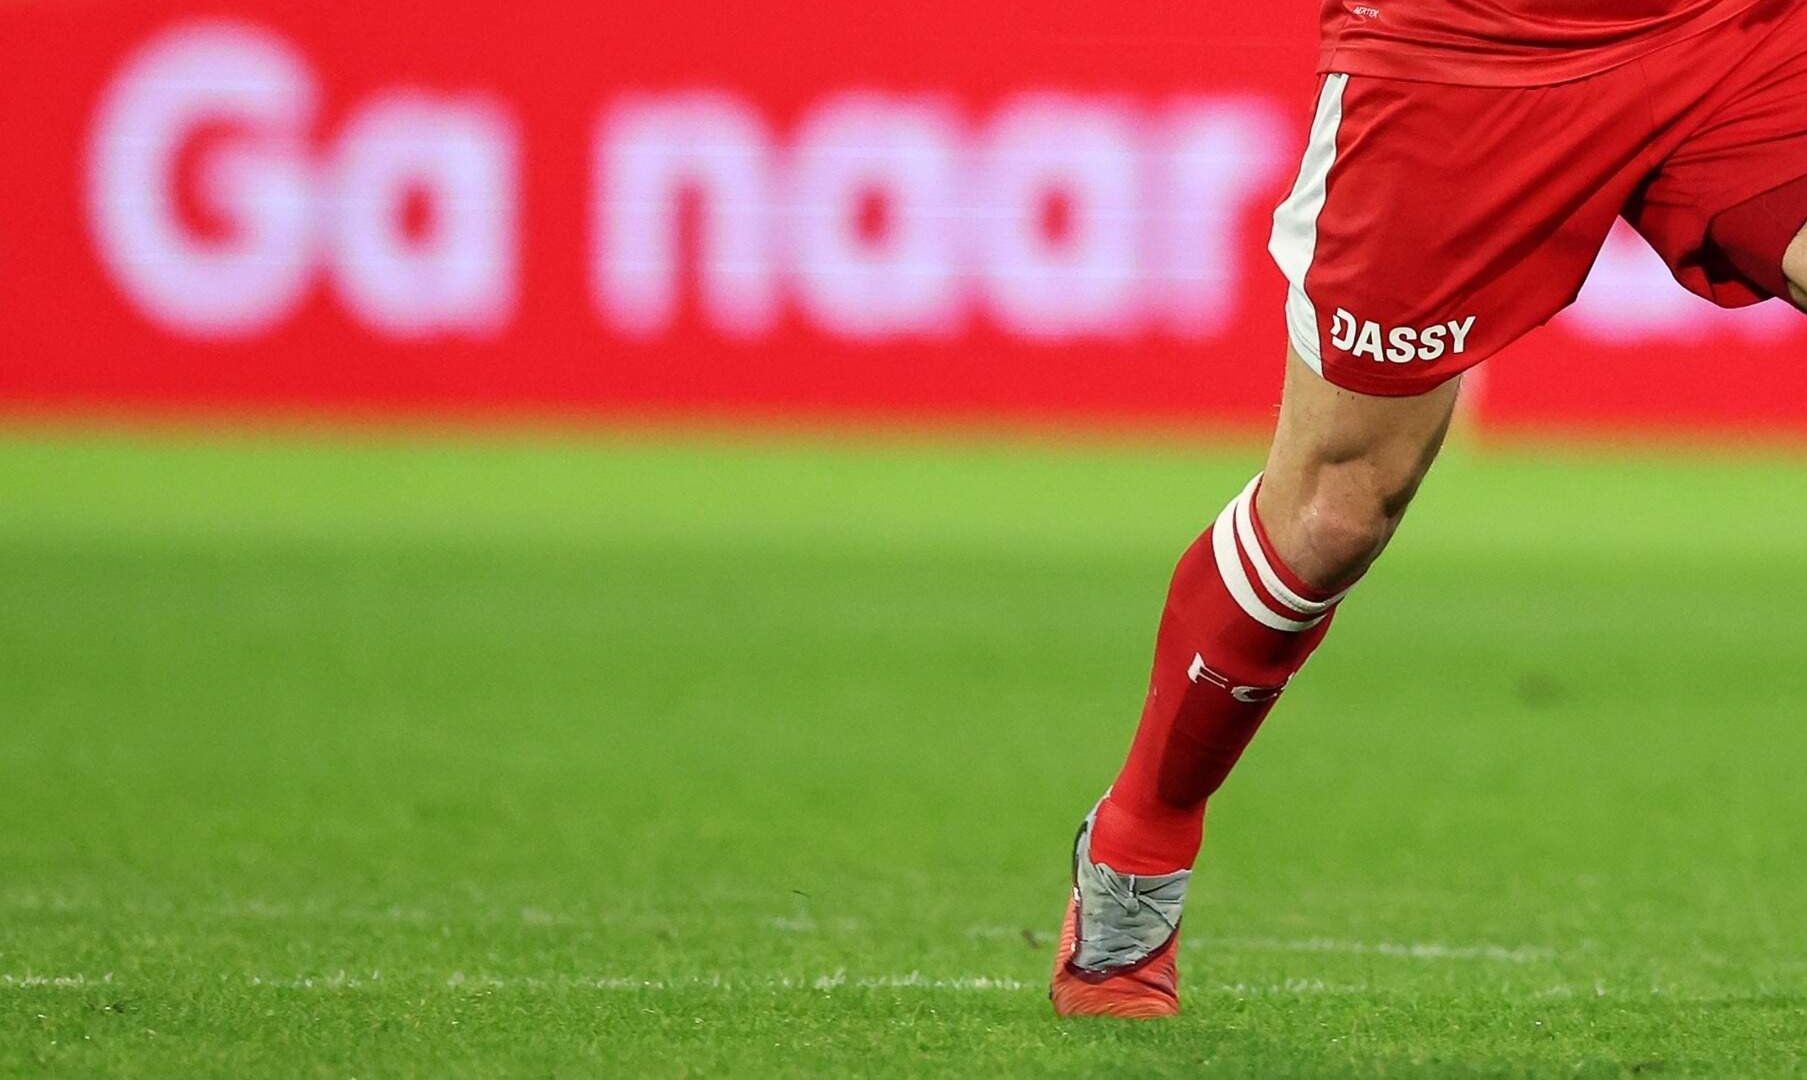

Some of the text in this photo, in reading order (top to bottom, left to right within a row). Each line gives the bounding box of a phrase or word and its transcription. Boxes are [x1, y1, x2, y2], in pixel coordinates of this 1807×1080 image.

[88, 17, 520, 338] Ga
[592, 88, 1290, 340] naar
[1330, 307, 1476, 363] DASSY
